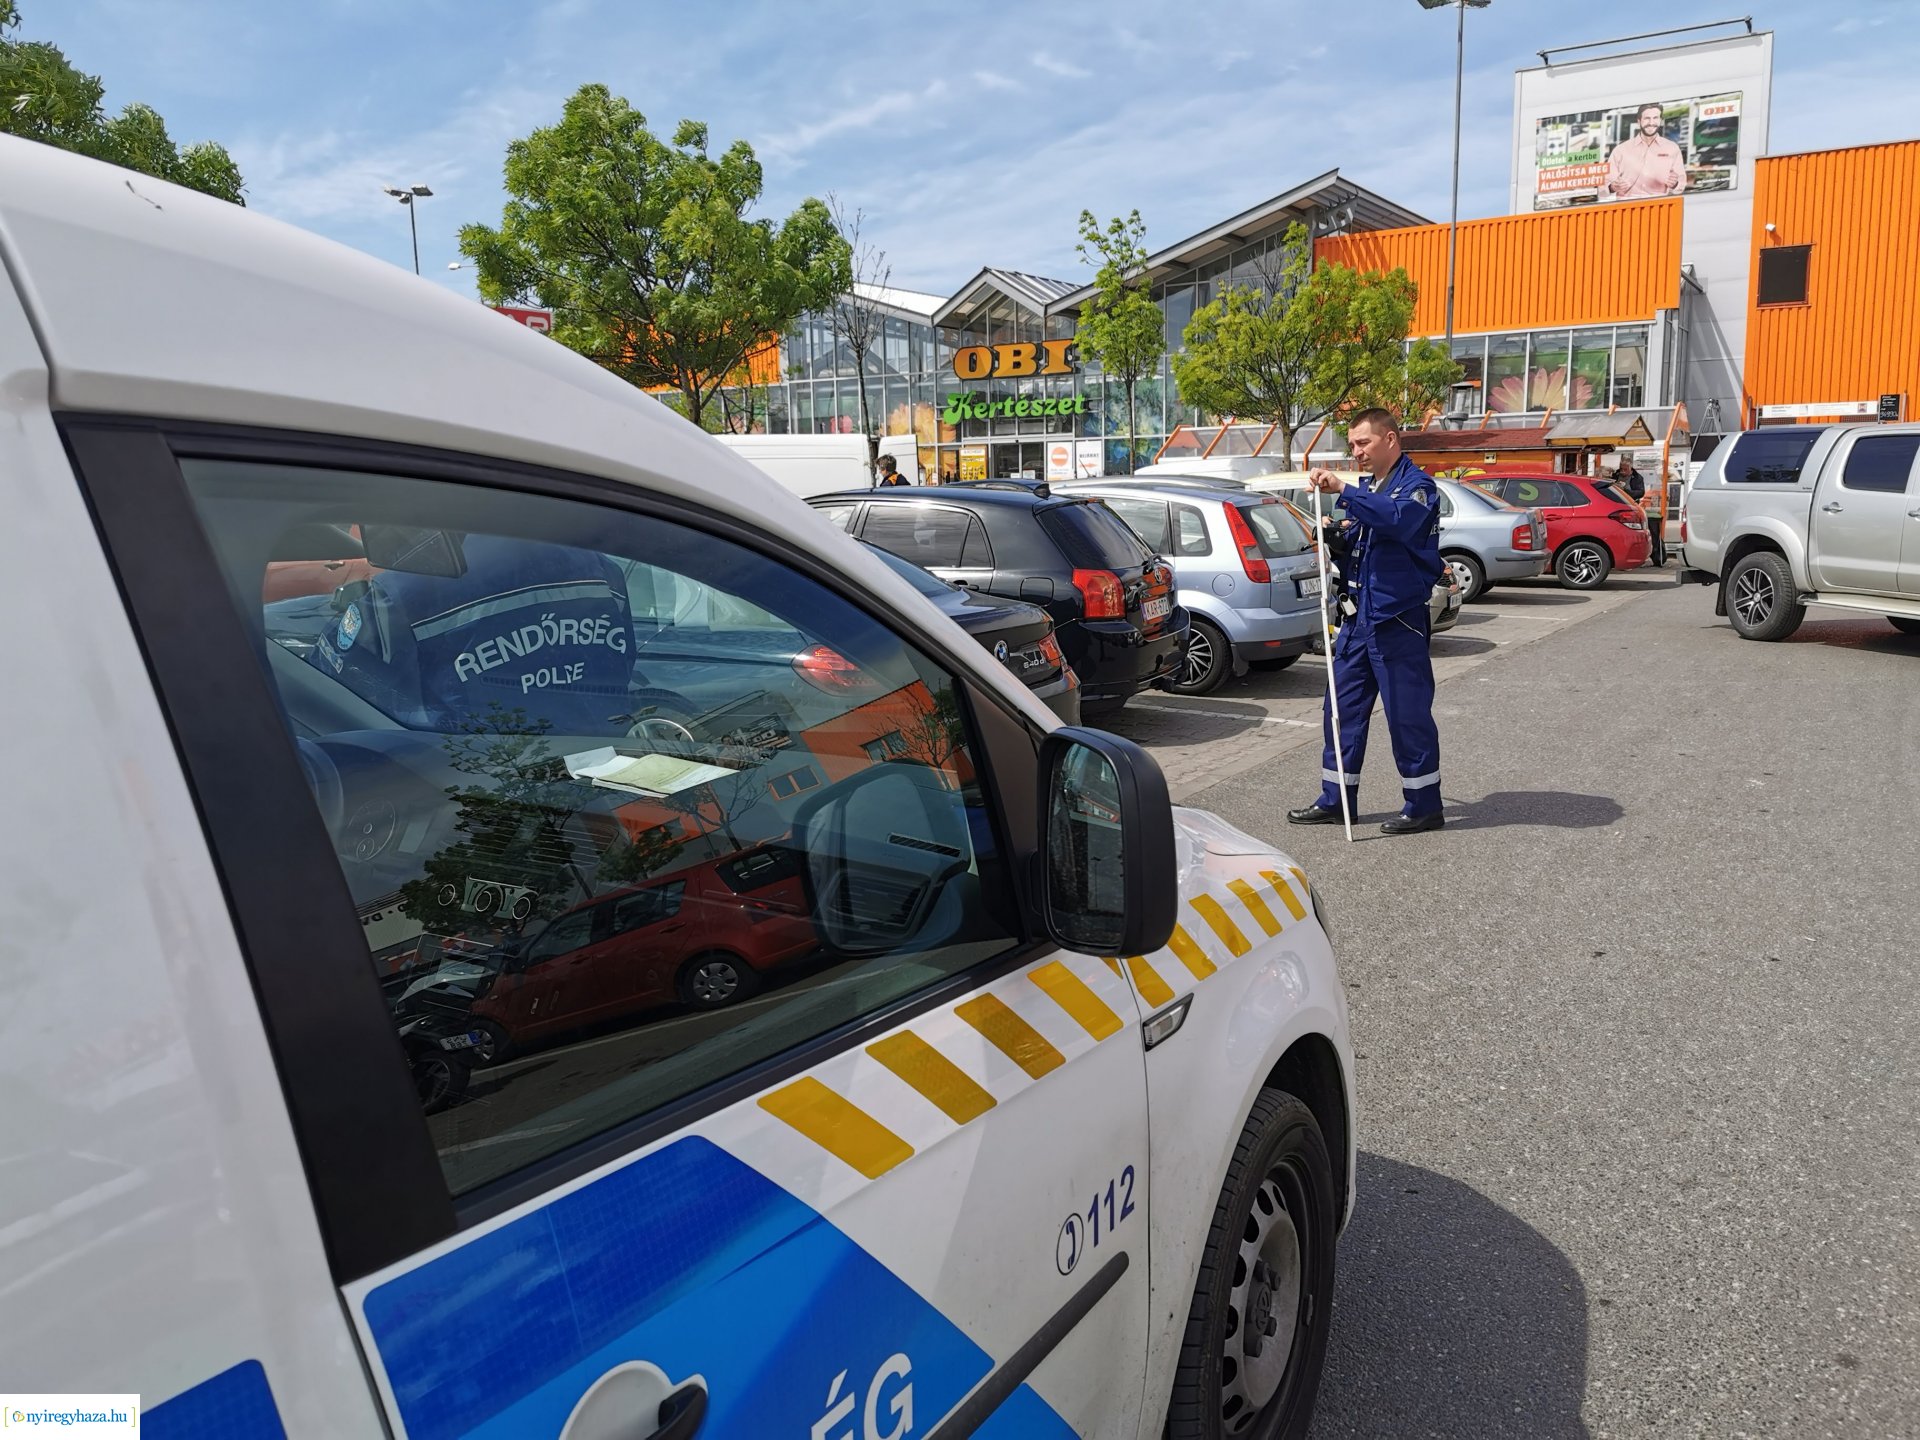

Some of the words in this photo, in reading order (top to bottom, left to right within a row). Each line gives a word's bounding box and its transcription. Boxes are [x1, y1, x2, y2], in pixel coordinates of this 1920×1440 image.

[1704, 105, 1735, 116] OBI
[1574, 153, 1598, 161] kertbe
[1541, 167, 1587, 180] VALÓSÍTSA
[1588, 165, 1609, 175] MEG
[1541, 179, 1566, 191] ÁLMAI
[953, 339, 1075, 380] OBI
[943, 390, 1087, 425] Kertészet
[454, 613, 627, 682] RENDŐRSÉG
[1088, 1165, 1136, 1248] 112
